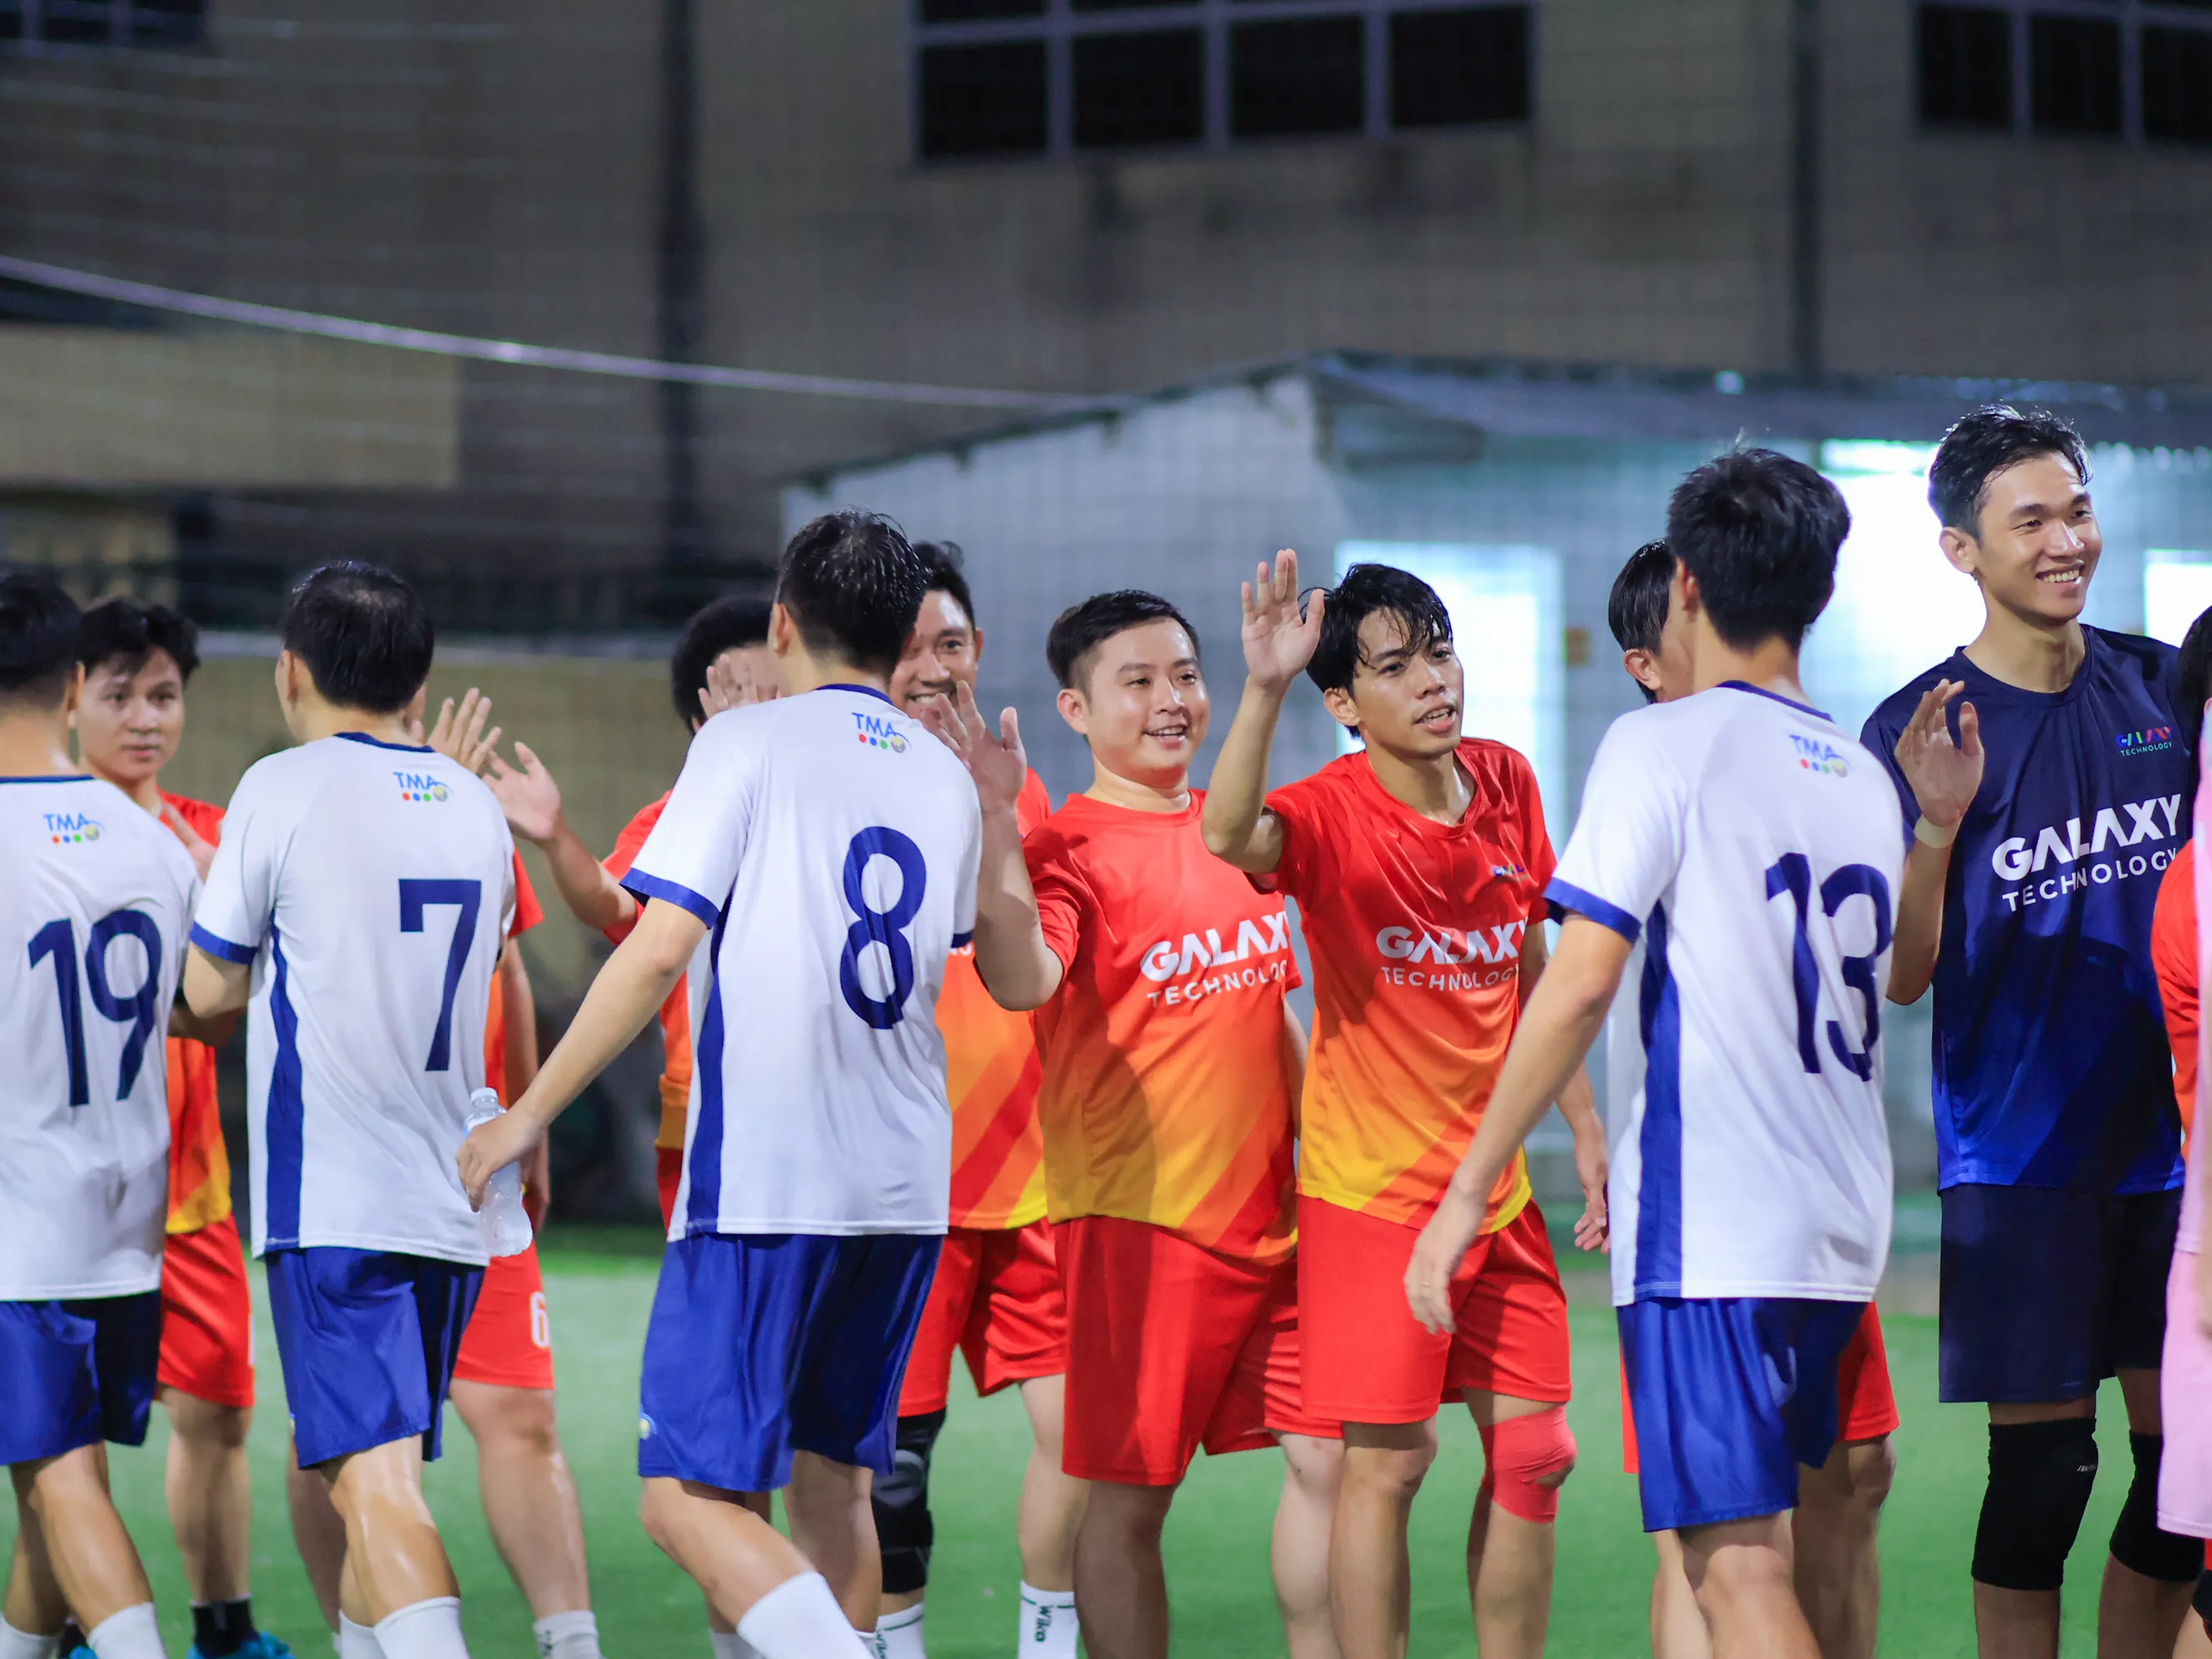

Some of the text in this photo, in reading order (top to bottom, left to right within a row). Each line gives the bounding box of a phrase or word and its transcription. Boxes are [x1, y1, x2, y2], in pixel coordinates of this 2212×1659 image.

[851, 712, 897, 737] TMA
[1789, 735, 1837, 761] TMA
[2120, 742, 2172, 756] TECHNOLOGY
[392, 771, 438, 790] TMA
[43, 813, 89, 831] TMA
[1992, 794, 2181, 881] GALAXY
[839, 826, 927, 1030] 8
[1141, 910, 1288, 982] GALAX
[398, 879, 482, 1072] 7
[1381, 964, 1519, 991] TECHNOLOG
[1765, 852, 1891, 1083] 13
[27, 909, 162, 1107] 19
[530, 1292, 550, 1348] 6
